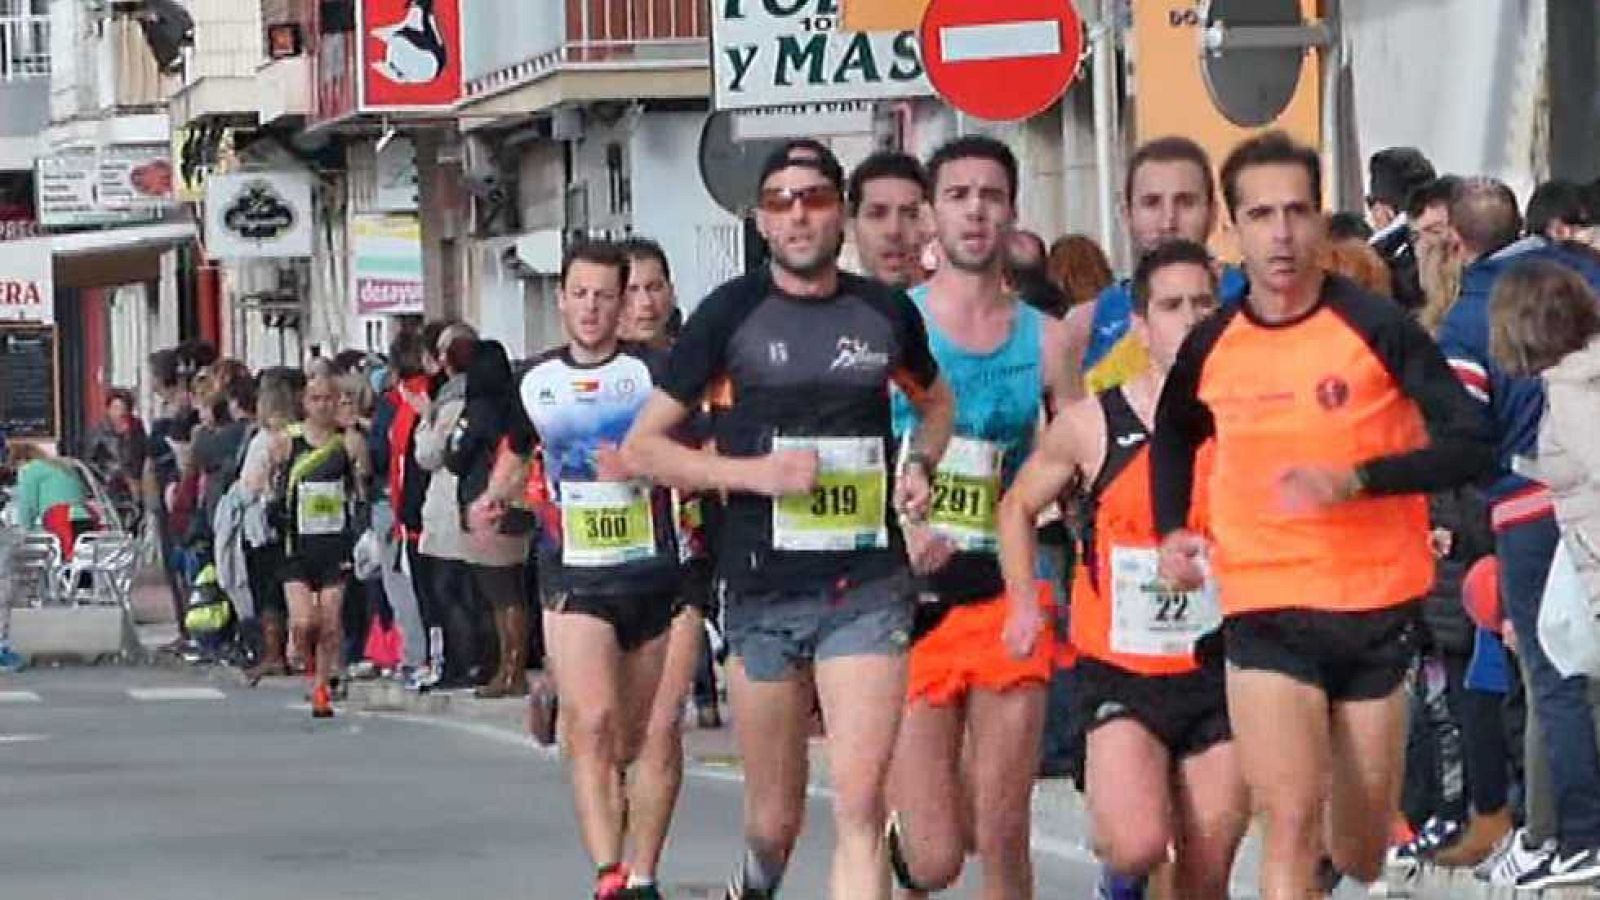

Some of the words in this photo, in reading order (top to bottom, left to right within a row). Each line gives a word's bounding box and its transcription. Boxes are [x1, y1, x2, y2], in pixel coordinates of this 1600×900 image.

[800, 17, 839, 32] 10
[725, 45, 759, 92] y
[774, 30, 925, 86] MAS
[811, 484, 858, 516] 319
[932, 484, 980, 517] 291
[585, 516, 628, 539] 300
[1155, 592, 1189, 622] 22
